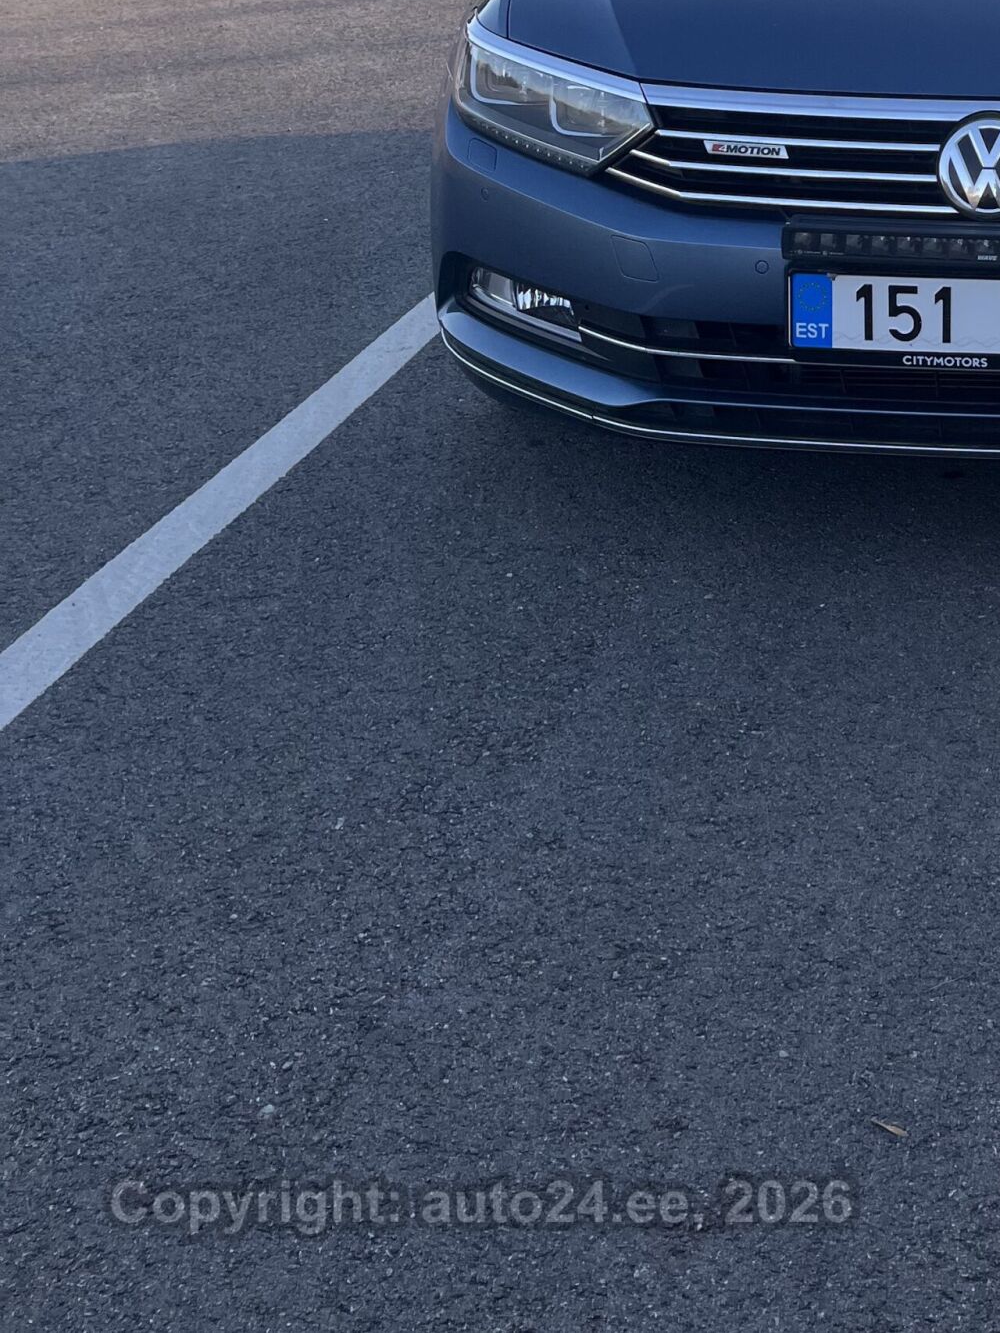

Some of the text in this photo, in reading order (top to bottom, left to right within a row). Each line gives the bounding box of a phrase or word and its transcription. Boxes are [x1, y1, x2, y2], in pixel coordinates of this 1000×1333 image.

[855, 283, 952, 344] 151
[795, 322, 829, 340] EST
[902, 355, 988, 368] CITYMOTORS
